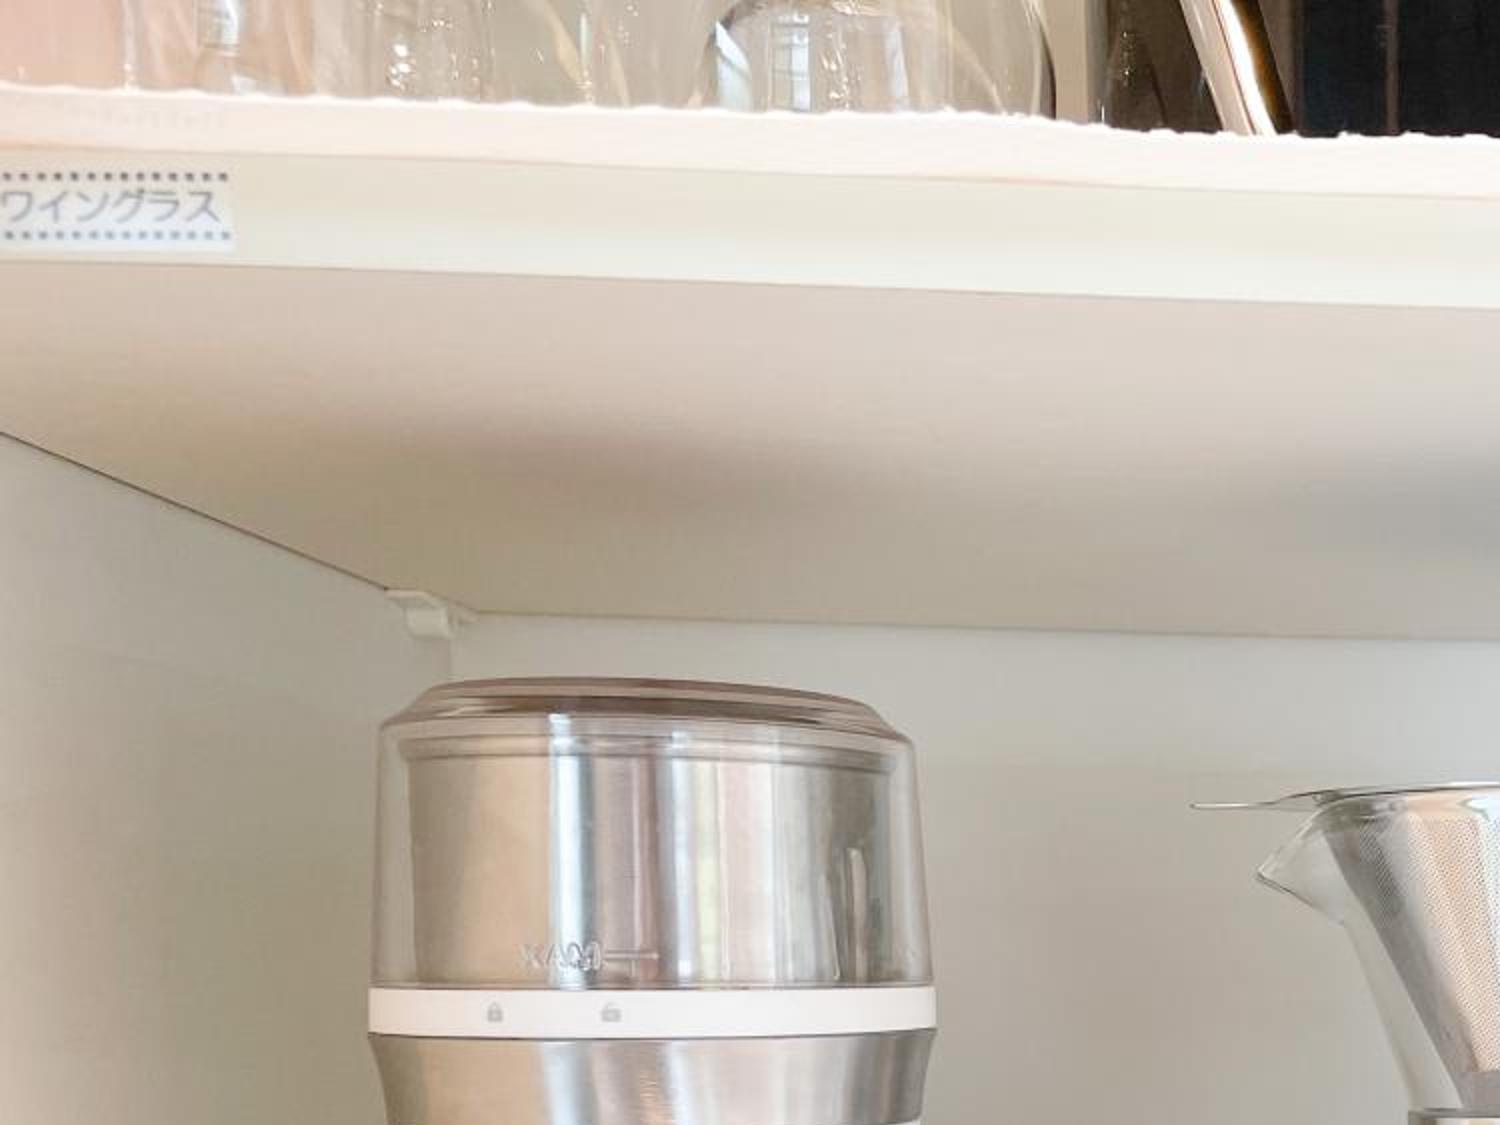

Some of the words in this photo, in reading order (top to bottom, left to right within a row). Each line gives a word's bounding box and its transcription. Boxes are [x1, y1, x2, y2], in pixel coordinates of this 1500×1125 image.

[1, 188, 221, 224] ワイングラス
